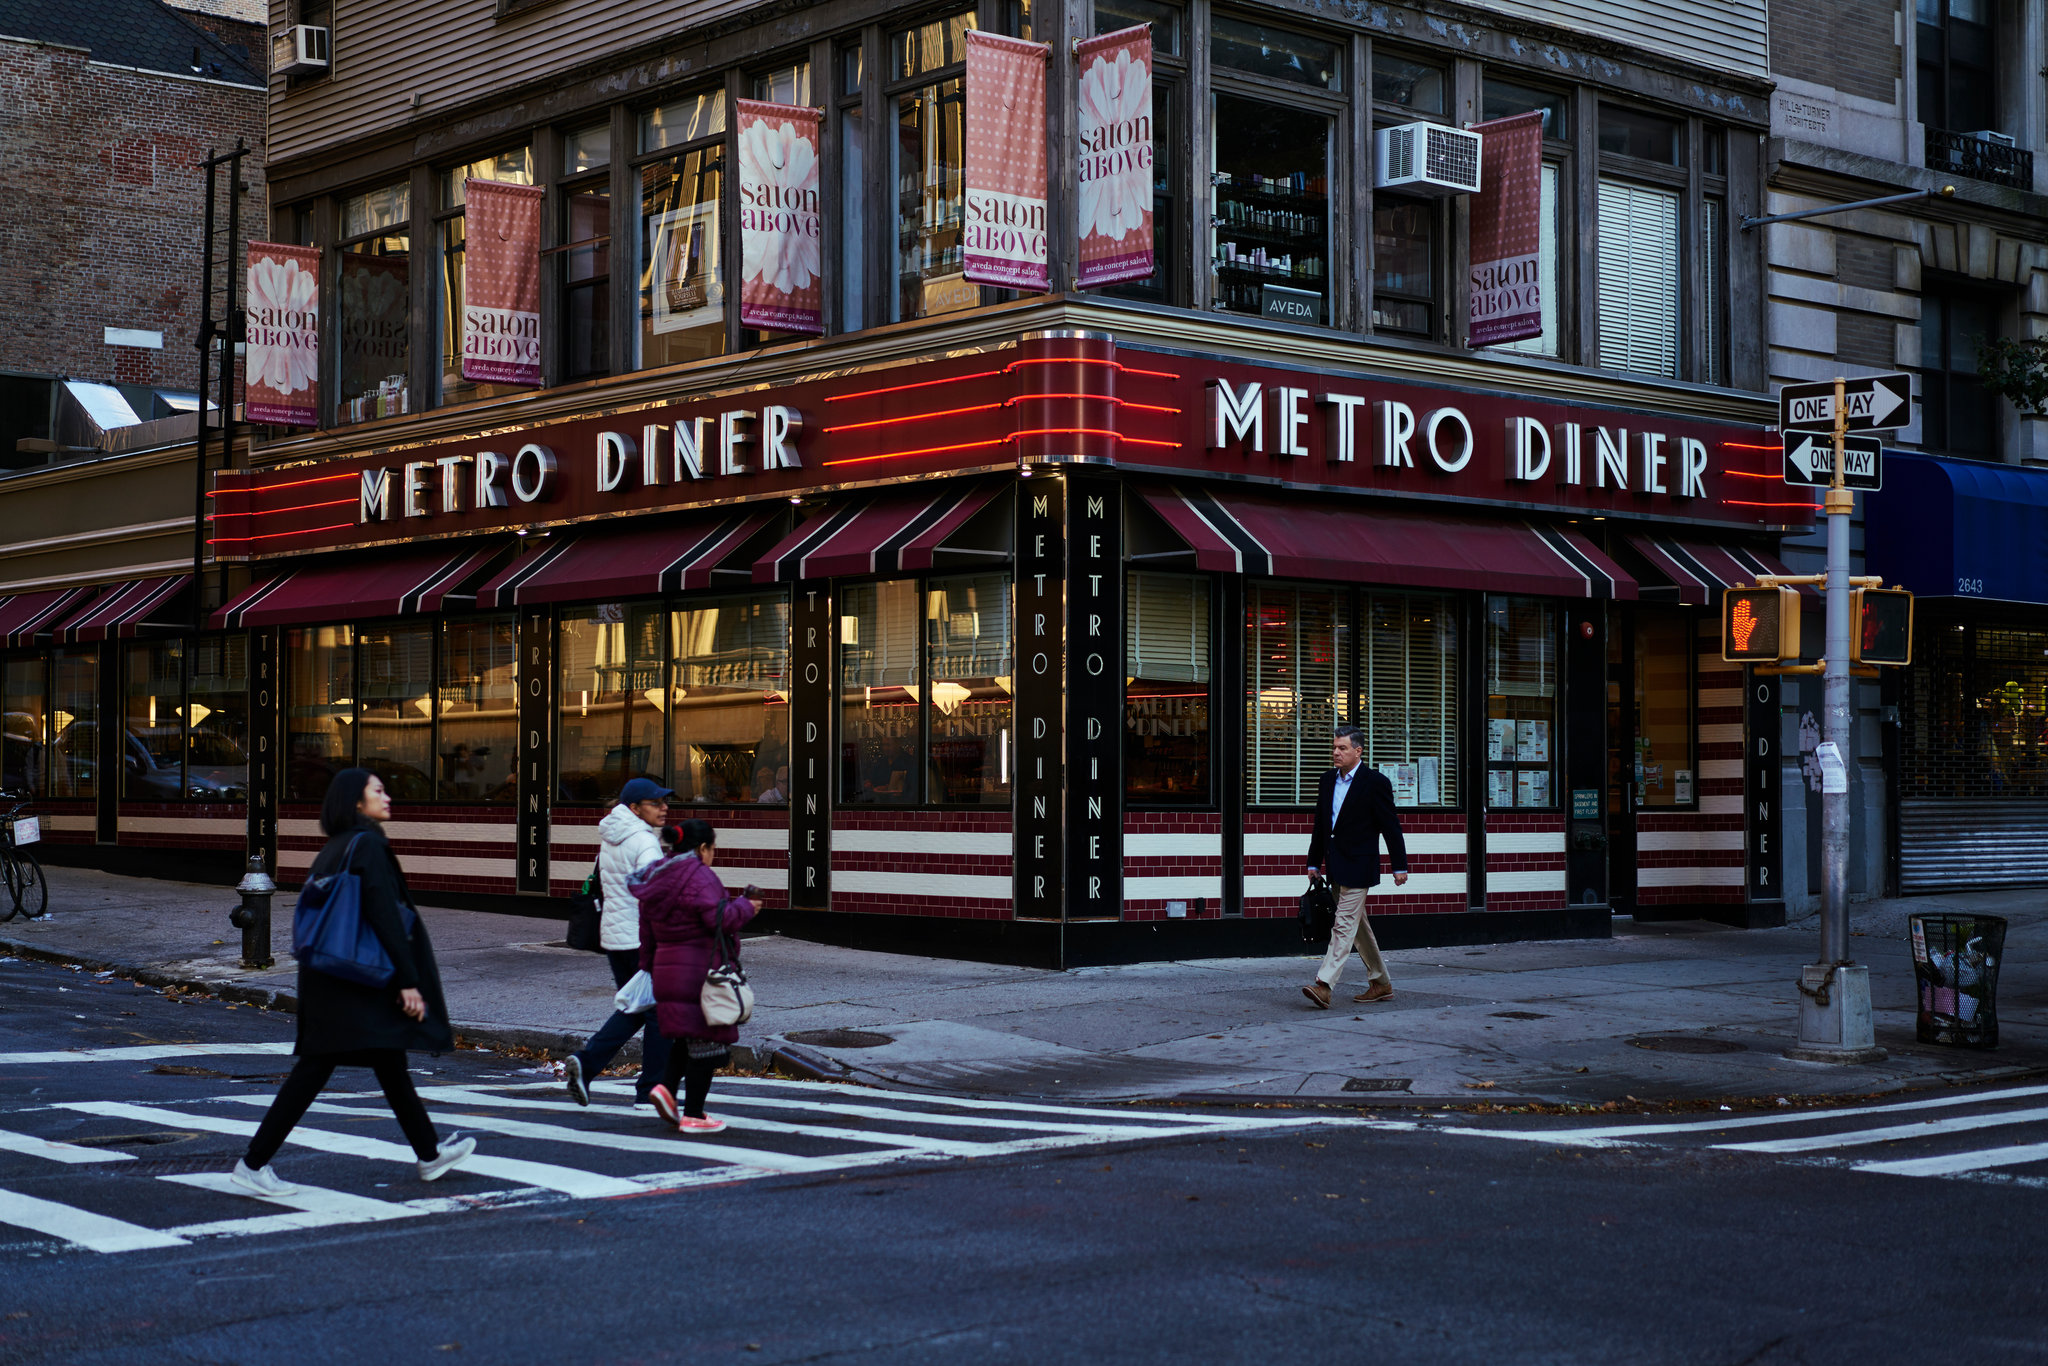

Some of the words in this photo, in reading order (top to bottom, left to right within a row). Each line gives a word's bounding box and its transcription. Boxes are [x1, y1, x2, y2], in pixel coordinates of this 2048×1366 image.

[1079, 115, 1151, 155] salon
[741, 182, 817, 213] salon
[967, 195, 1046, 231] salon
[972, 262, 992, 270] aveda
[994, 264, 1021, 276] concept
[1022, 267, 1040, 276] salon
[1086, 263, 1104, 273] aveda
[1104, 259, 1129, 269] concept
[1130, 256, 1146, 266] salon
[1470, 260, 1537, 293] salon
[247, 305, 316, 331] salon
[466, 311, 537, 339] salon
[749, 308, 769, 316] aveda
[770, 312, 795, 320] concept
[796, 312, 814, 321] salon
[1269, 299, 1313, 318] AVEDA
[1494, 322, 1517, 330] concept
[1518, 318, 1534, 326] salon
[490, 367, 515, 376] concept
[271, 408, 294, 416] concept
[1794, 398, 1828, 420] ONE
[1206, 377, 1474, 473] METRO
[1505, 416, 1708, 499] DINER
[361, 443, 557, 524] METRO
[596, 405, 803, 492] DINER
[1844, 451, 1871, 473] WAY
[1032, 494, 1048, 675] METRO
[1086, 495, 1104, 676] METRO
[1958, 577, 1983, 594] 2643
[805, 591, 818, 684] TRO
[259, 634, 269, 707] TRO
[530, 614, 542, 697] TRO
[529, 730, 540, 878] DINER
[806, 722, 818, 888] DINER
[1033, 717, 1047, 899] DINER
[1087, 716, 1102, 899] DINER
[1758, 737, 1770, 886] DINER
